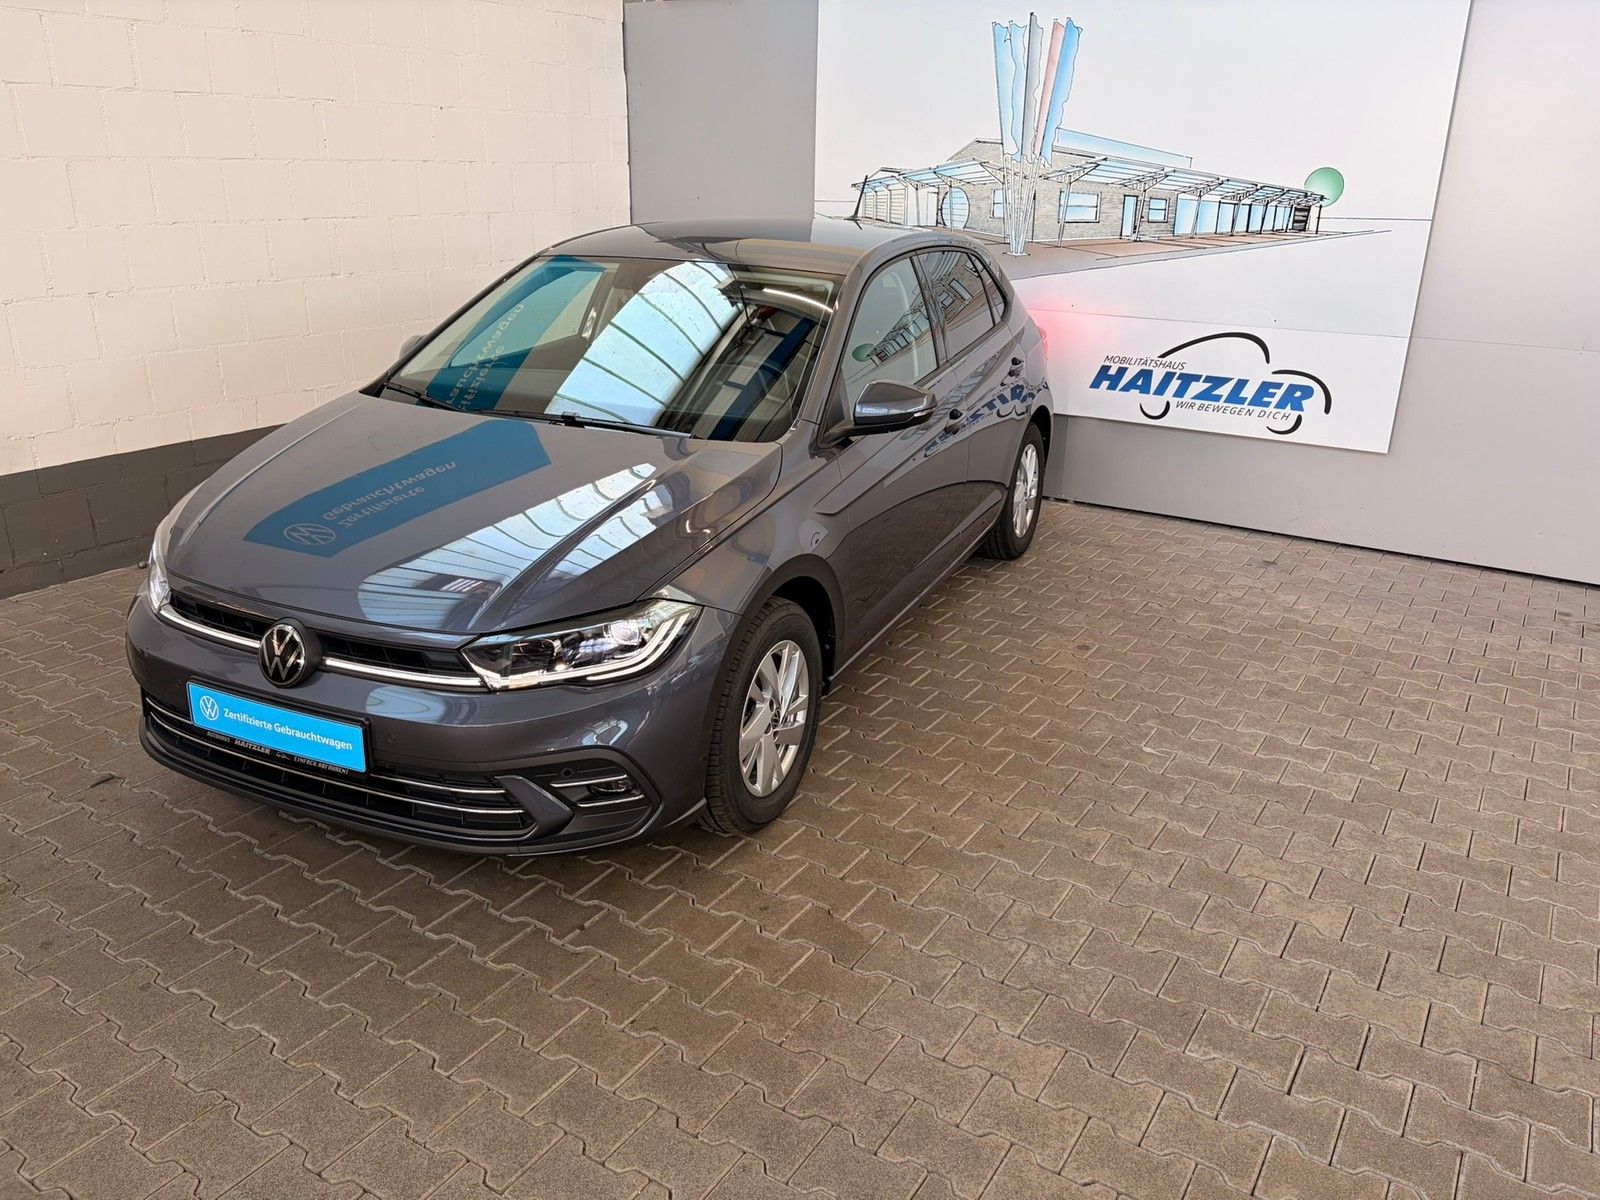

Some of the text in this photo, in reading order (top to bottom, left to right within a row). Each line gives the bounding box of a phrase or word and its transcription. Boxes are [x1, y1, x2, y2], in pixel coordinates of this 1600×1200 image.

[1103, 354, 1187, 371] MOBILITÄTSHAUS
[1089, 364, 1315, 413] HAITZLER
[1175, 400, 1291, 421] WIR BEWEGEN DICH
[223, 708, 273, 731] Zertifizierte
[273, 722, 353, 750] Gebrauchtwagen
[234, 738, 271, 755] HAITZLER
